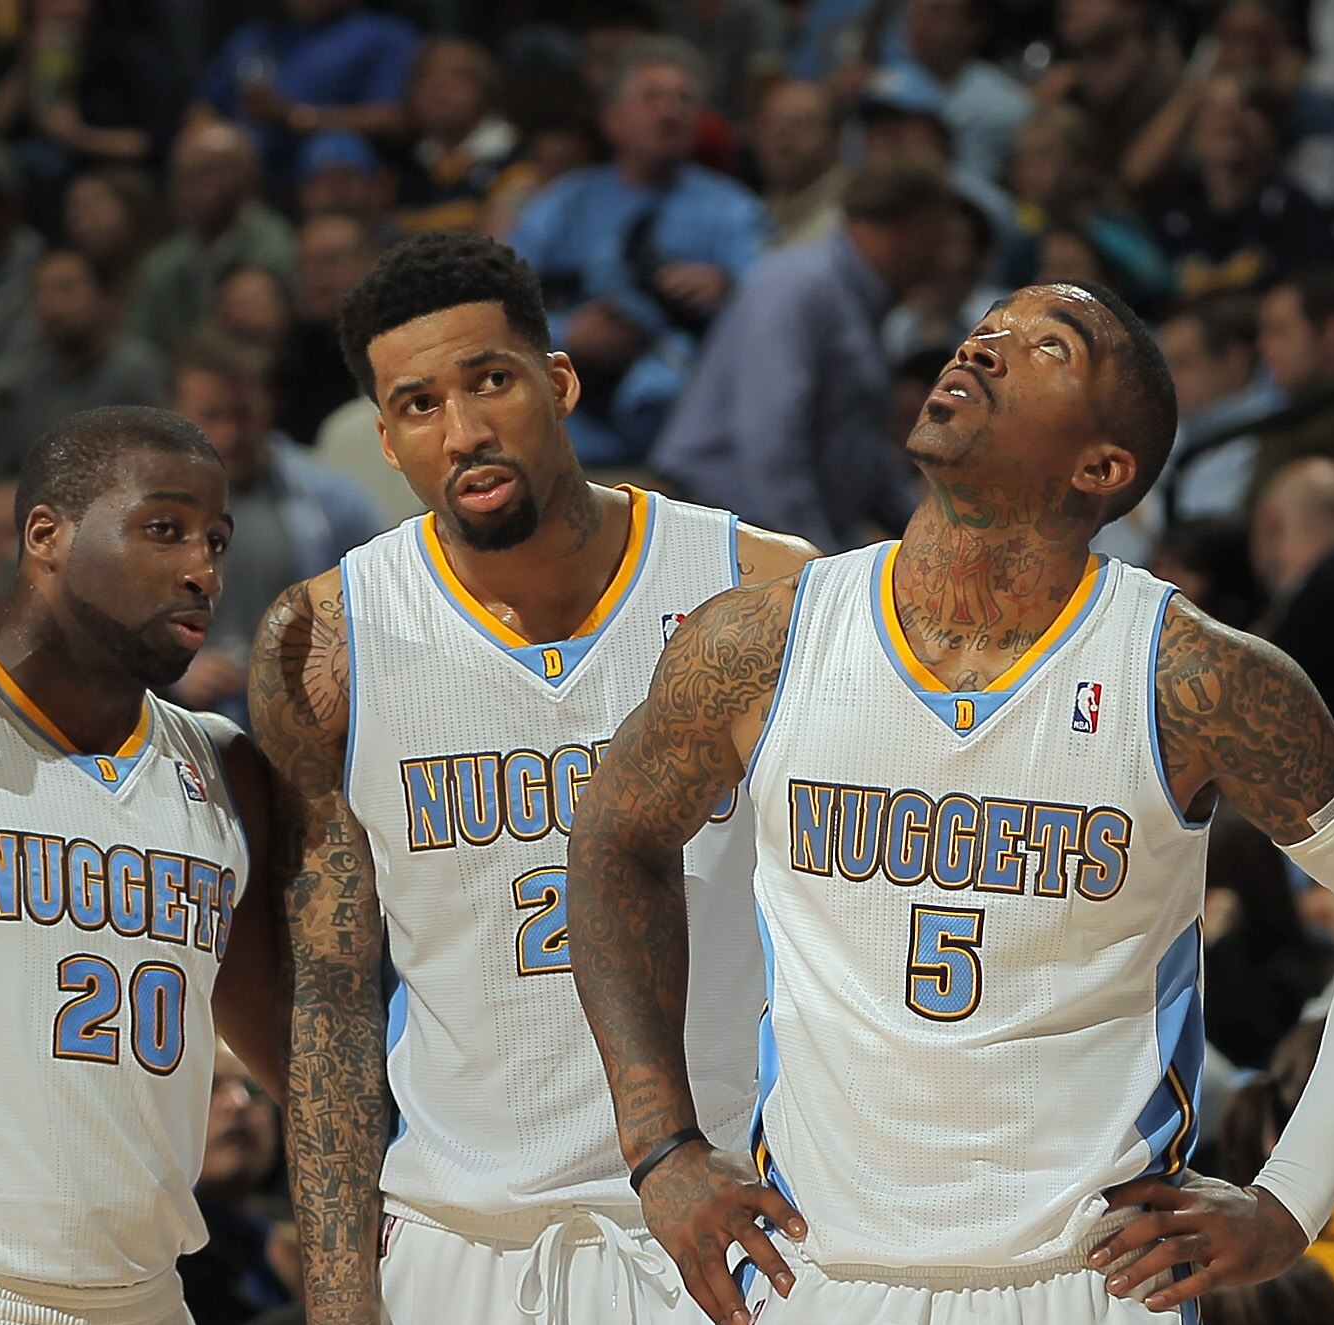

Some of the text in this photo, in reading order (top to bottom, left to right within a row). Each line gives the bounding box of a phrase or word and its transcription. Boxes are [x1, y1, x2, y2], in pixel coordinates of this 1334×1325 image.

[541, 647, 564, 680] D
[954, 699, 974, 732] D
[787, 779, 1134, 902] NUGGETS
[53, 953, 187, 1076] 20
[905, 902, 986, 1023] 5
